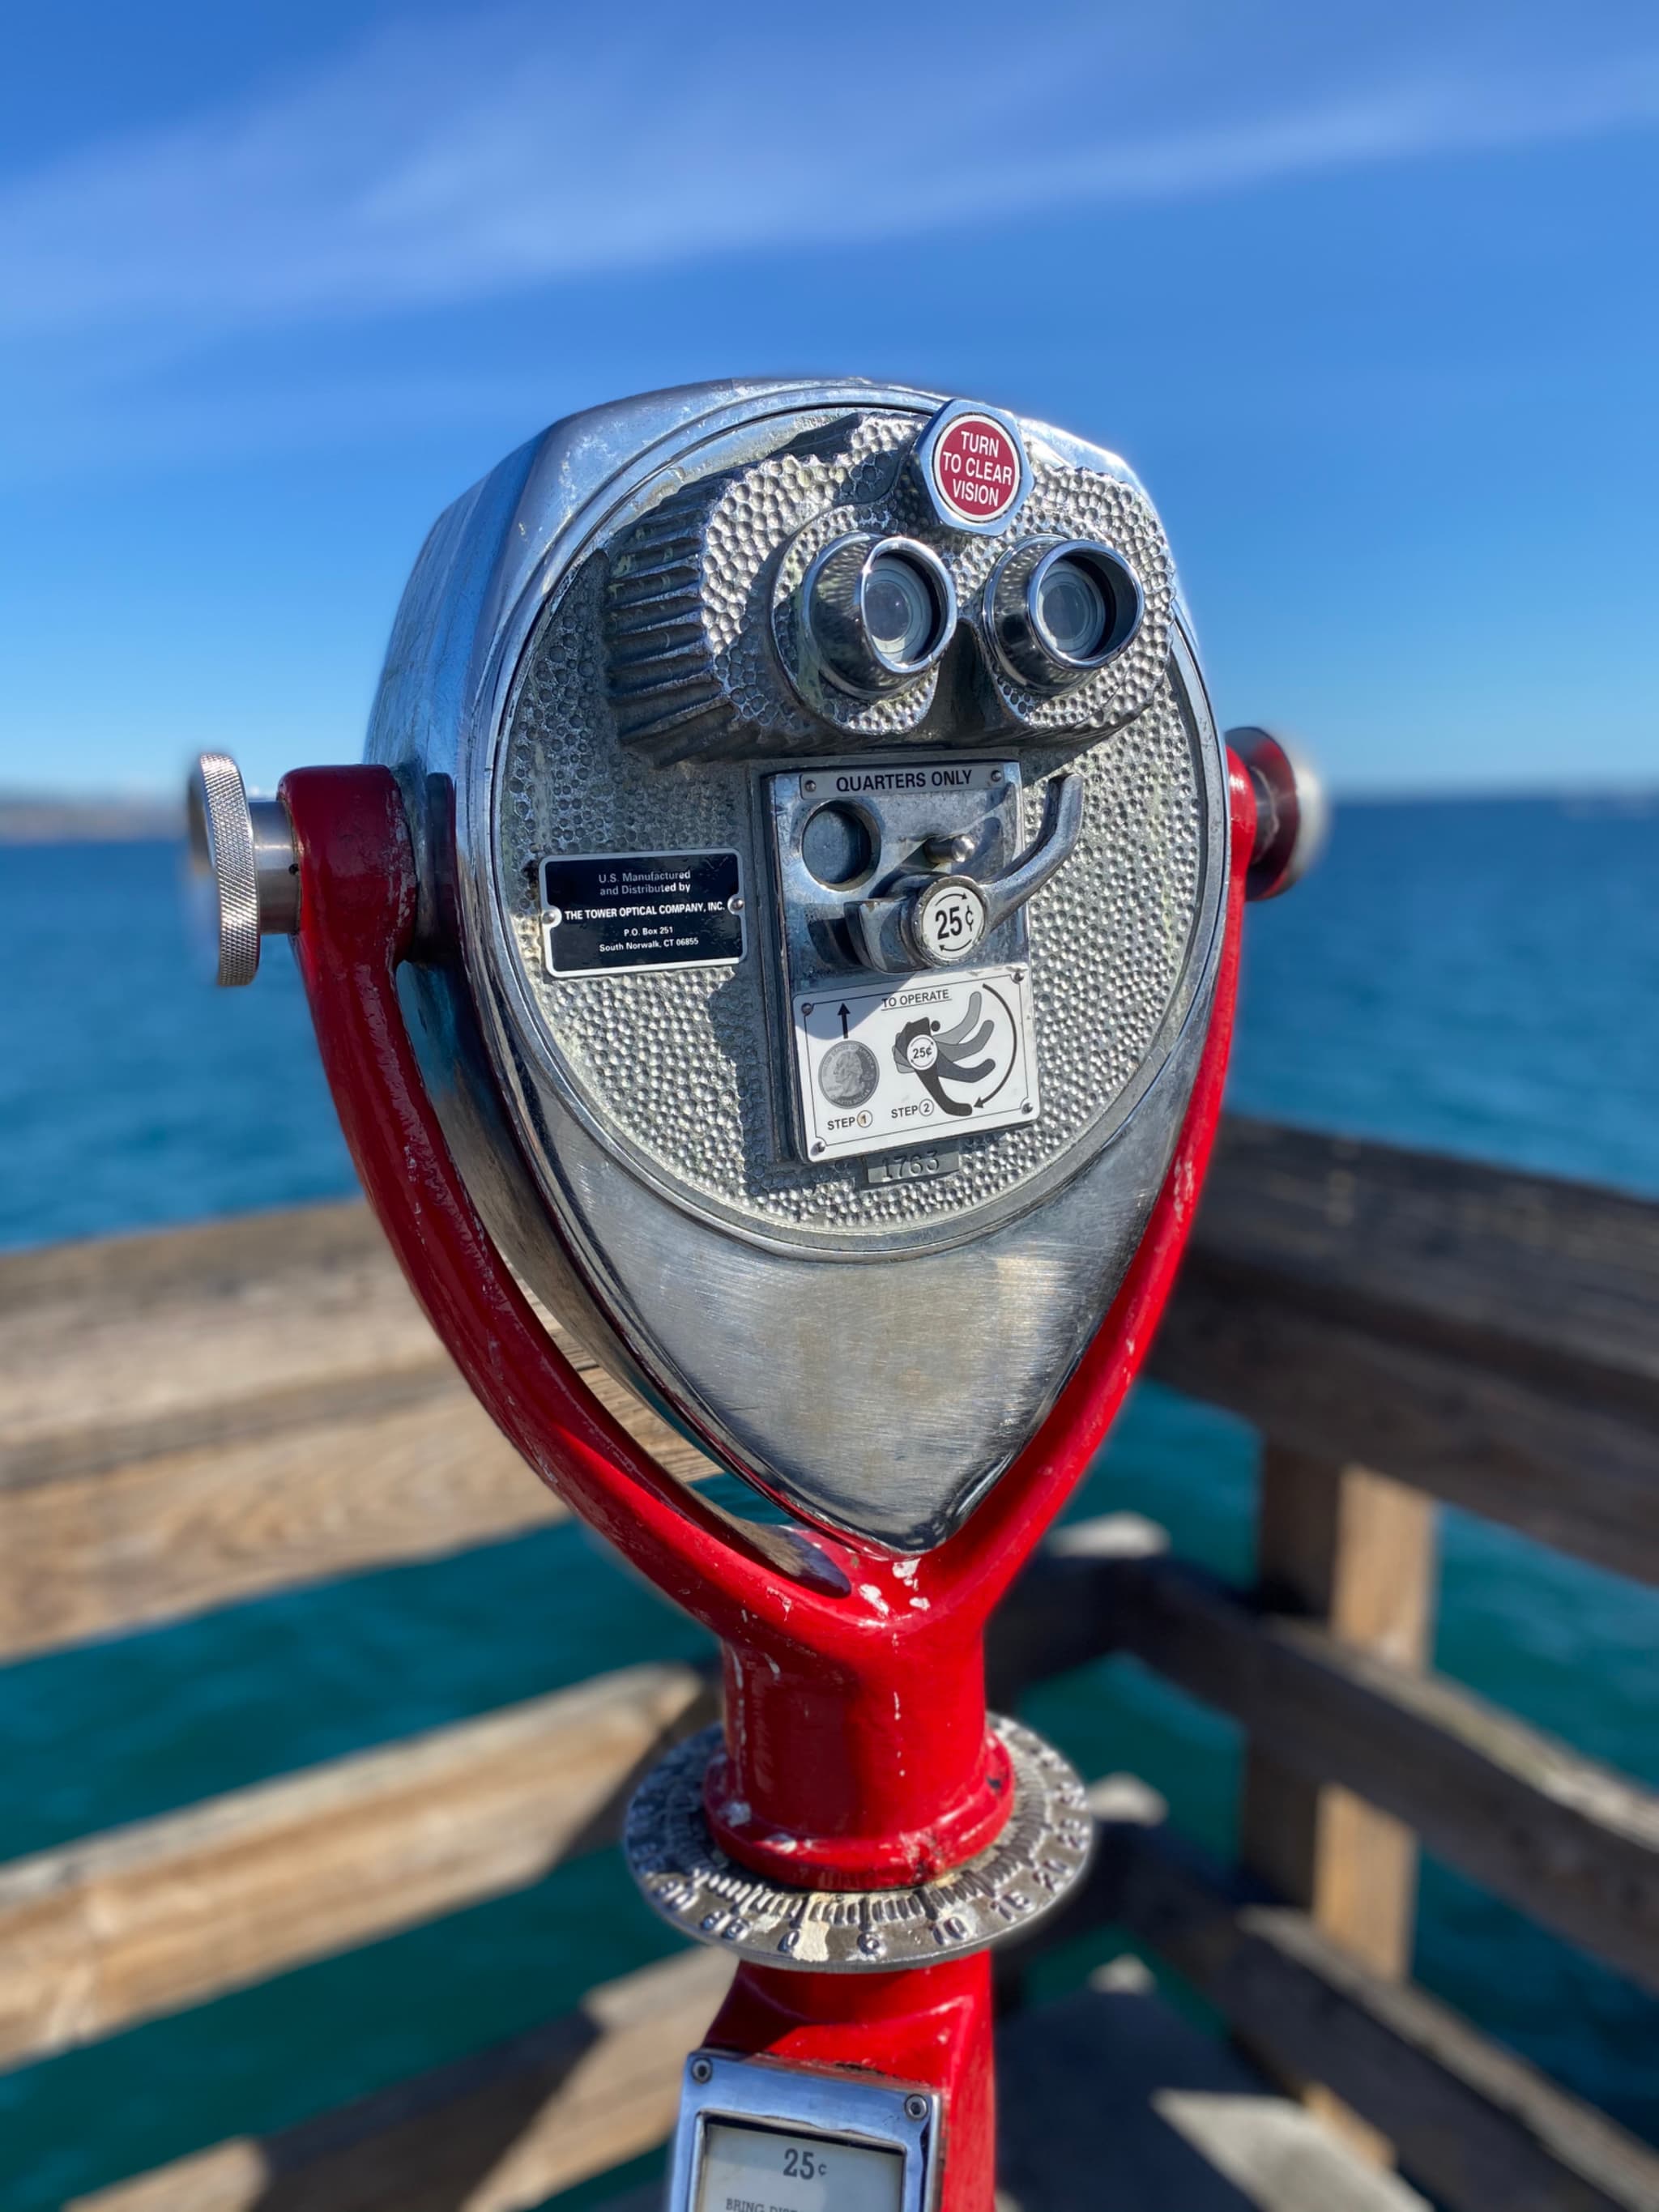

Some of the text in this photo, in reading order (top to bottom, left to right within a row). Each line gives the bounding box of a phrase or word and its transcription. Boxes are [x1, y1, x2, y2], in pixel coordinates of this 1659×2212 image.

[961, 430, 1000, 458] TURN
[943, 451, 1013, 486] TO CLEAR
[952, 478, 1000, 507] VISION
[836, 769, 972, 792] QUARTERS ONLY
[598, 869, 691, 884] U.S. Manufactured
[599, 882, 691, 896] and Distributed by
[565, 901, 726, 921] THE TOWER OPTICAL COMPANY, INC.
[624, 926, 673, 937] P.O. Box 251
[935, 905, 975, 940] 25¢
[599, 936, 699, 953] South Norwalk, CT 06855
[881, 989, 949, 1008] TO OPERATE
[912, 1046, 932, 1059] 25¢
[891, 1105, 918, 1119] STEP
[827, 1116, 855, 1131] STEP
[881, 1150, 940, 1182] 1763
[726, 2197, 764, 2212] BRING
